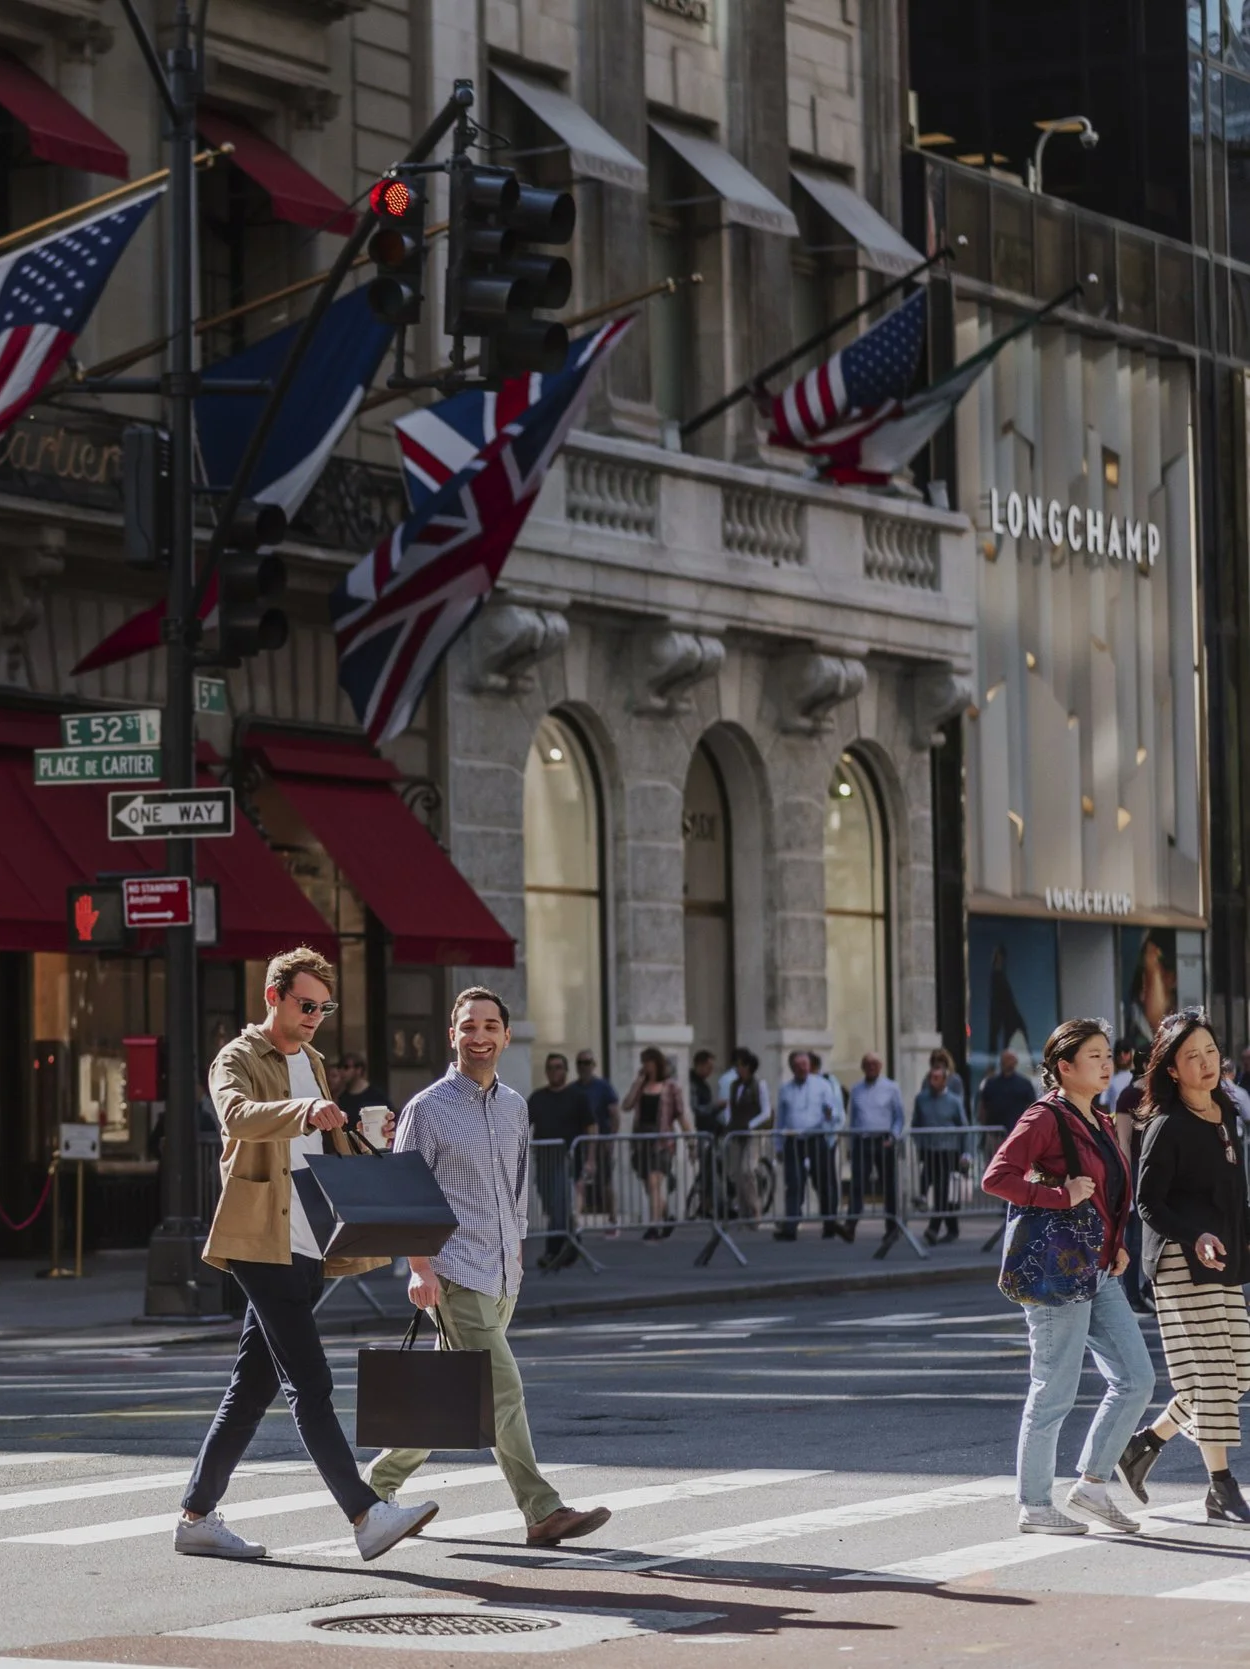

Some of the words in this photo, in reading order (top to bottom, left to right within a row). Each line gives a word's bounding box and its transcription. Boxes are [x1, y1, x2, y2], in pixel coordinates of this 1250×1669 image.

[990, 487, 1161, 566] LONGCHAMP
[201, 683, 210, 709] 5
[65, 719, 82, 745] E
[90, 717, 125, 744] 52
[125, 717, 141, 730] ST
[39, 756, 80, 777] PLACE
[101, 754, 154, 776] CARTIER
[128, 805, 162, 824] ONE
[178, 803, 216, 823] WAY
[128, 884, 139, 894] NO
[141, 883, 179, 894] STANDING
[1045, 886, 1132, 916] LONGCHAMP
